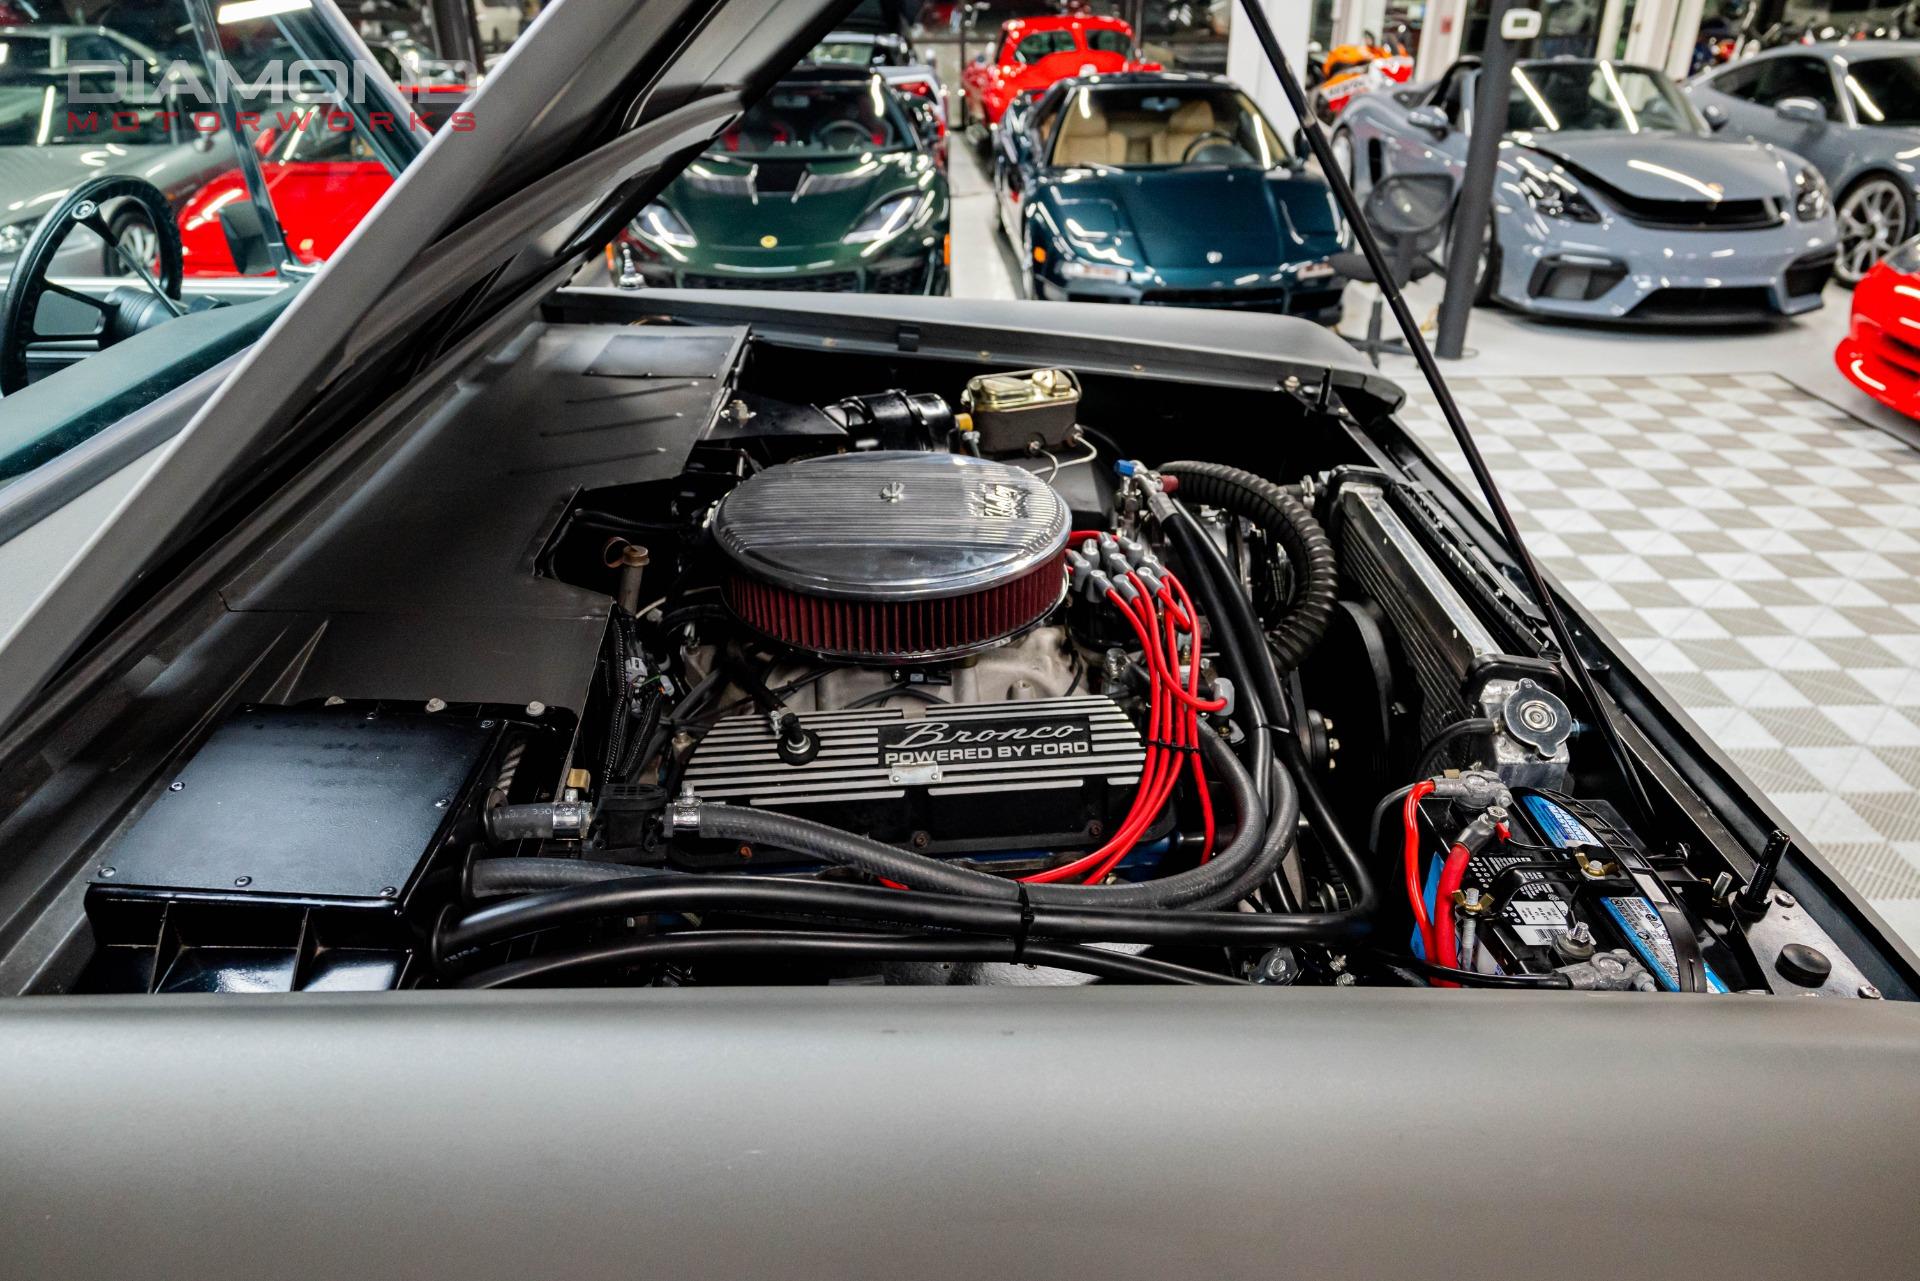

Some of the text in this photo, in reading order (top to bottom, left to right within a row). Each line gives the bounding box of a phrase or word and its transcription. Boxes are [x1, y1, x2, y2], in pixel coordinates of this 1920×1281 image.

[885, 722, 1083, 749] Bronco
[885, 741, 1089, 765] POWERED BY FORD
